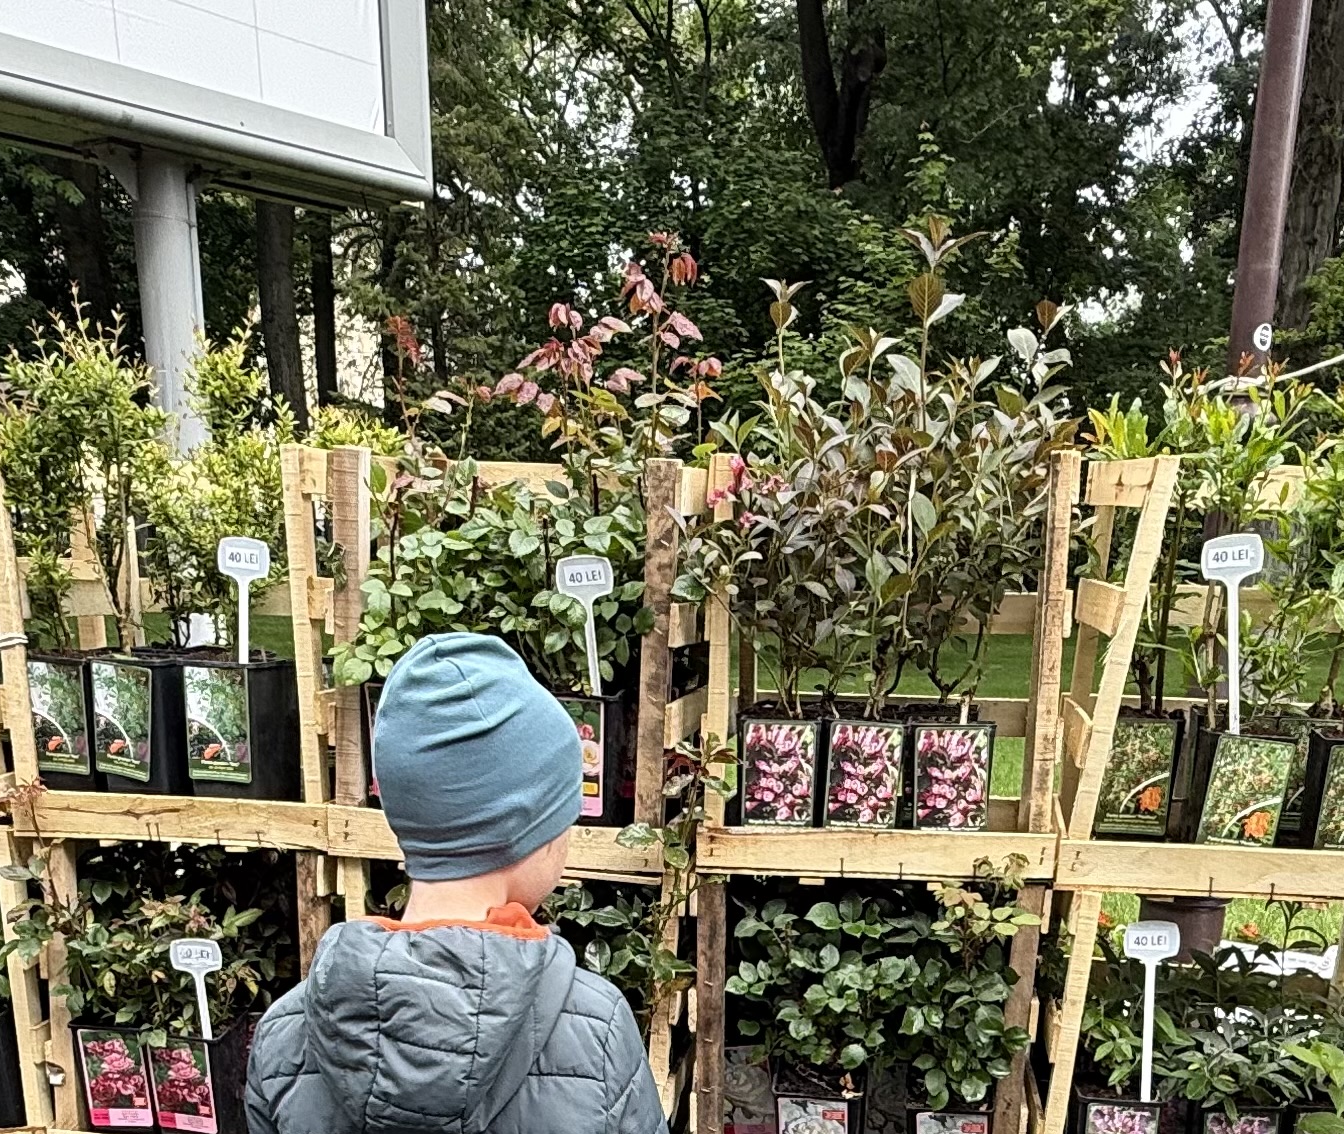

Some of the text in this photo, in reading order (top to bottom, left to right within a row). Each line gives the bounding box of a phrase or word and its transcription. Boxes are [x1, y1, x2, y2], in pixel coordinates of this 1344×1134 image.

[228, 551, 259, 565] 40 LEI
[1211, 549, 1248, 563] 40 LEI
[568, 570, 602, 584] 40 LEI
[1133, 935, 1167, 946] 40 LEI
